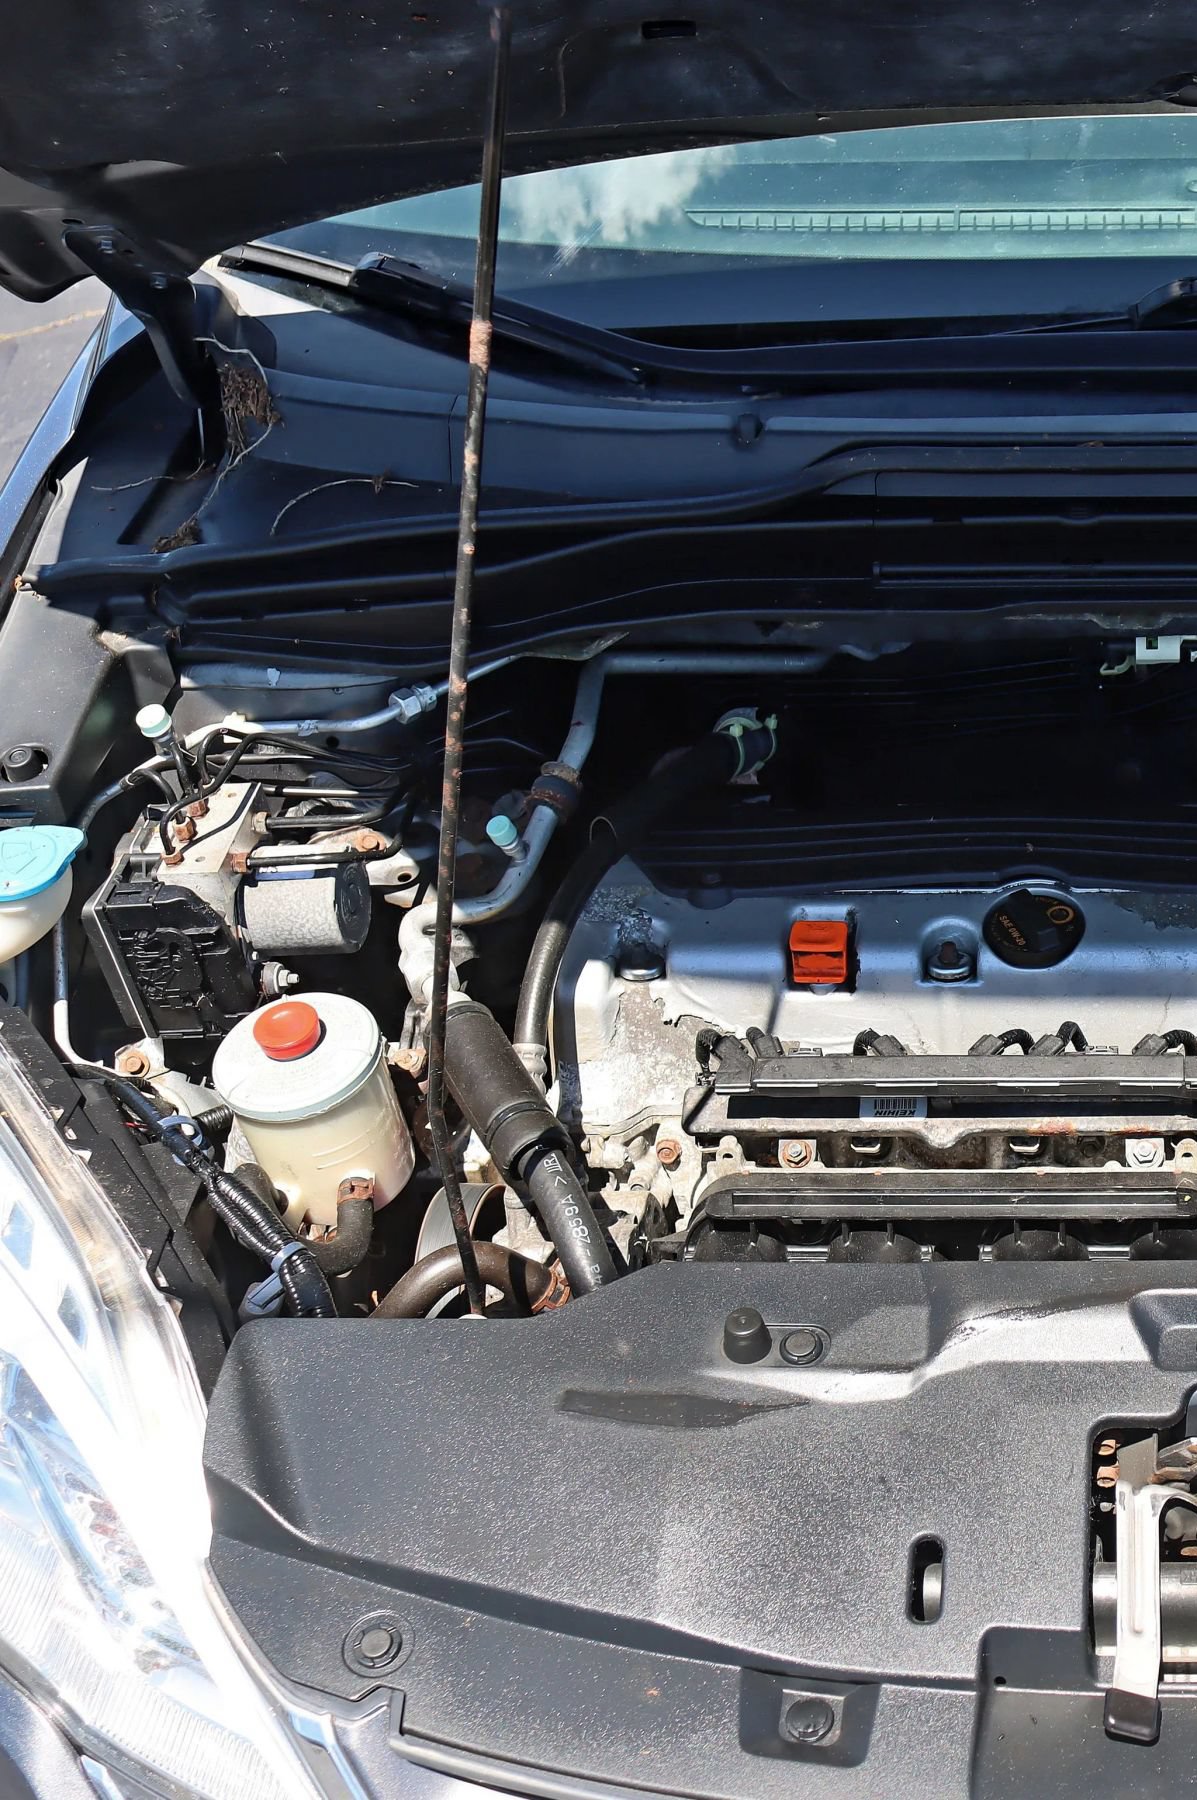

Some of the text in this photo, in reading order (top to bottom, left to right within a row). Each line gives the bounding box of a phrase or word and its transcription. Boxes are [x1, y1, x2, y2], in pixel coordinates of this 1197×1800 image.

[1000, 915, 1026, 946] SAE 0W-20
[874, 1110, 916, 1118] KEIHIN
